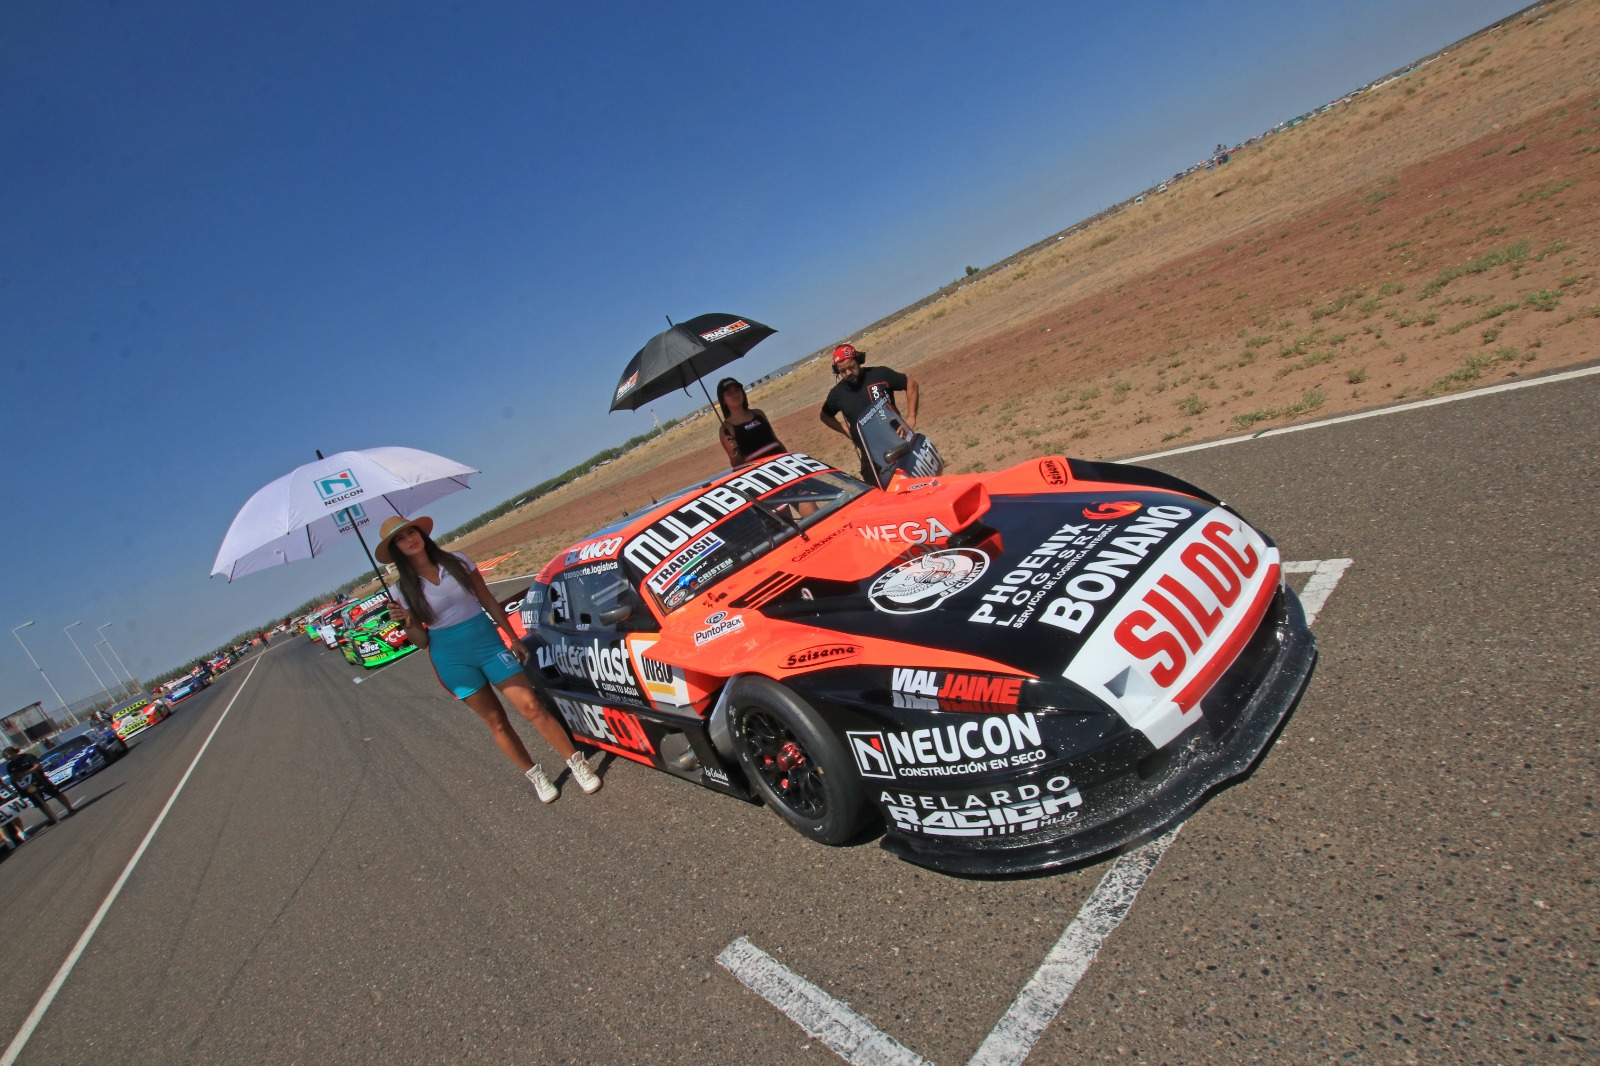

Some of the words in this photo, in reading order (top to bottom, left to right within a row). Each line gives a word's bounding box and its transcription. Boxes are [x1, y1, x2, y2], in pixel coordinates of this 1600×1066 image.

[324, 488, 364, 507] NEUCON
[624, 452, 830, 574] MULTIBANDAS
[564, 536, 624, 567] BLANCO
[858, 517, 952, 544] WEGA
[651, 534, 718, 586] TRABASIL
[697, 557, 734, 583] CRISTEM
[968, 523, 1090, 624] PHOENIX
[1013, 590, 1045, 629] SERVICIO
[1042, 576, 1056, 590] DE
[1054, 549, 1090, 580] LOGISTICA
[1084, 524, 1118, 550] INTEGRAL
[1038, 505, 1193, 634] BONANO
[1113, 520, 1259, 688] SILOC
[695, 617, 741, 642] PuntoPack
[536, 637, 636, 689] waterplast
[787, 646, 855, 667] Seiseme
[938, 673, 1024, 705] JAIME
[552, 696, 656, 755] PRADECON
[887, 712, 1043, 765] NEUCON
[899, 761, 988, 777] CONSTRUCCIÓN
[990, 758, 1009, 769] EN
[1011, 749, 1047, 766] SECO
[880, 776, 1070, 810] ABELARDO
